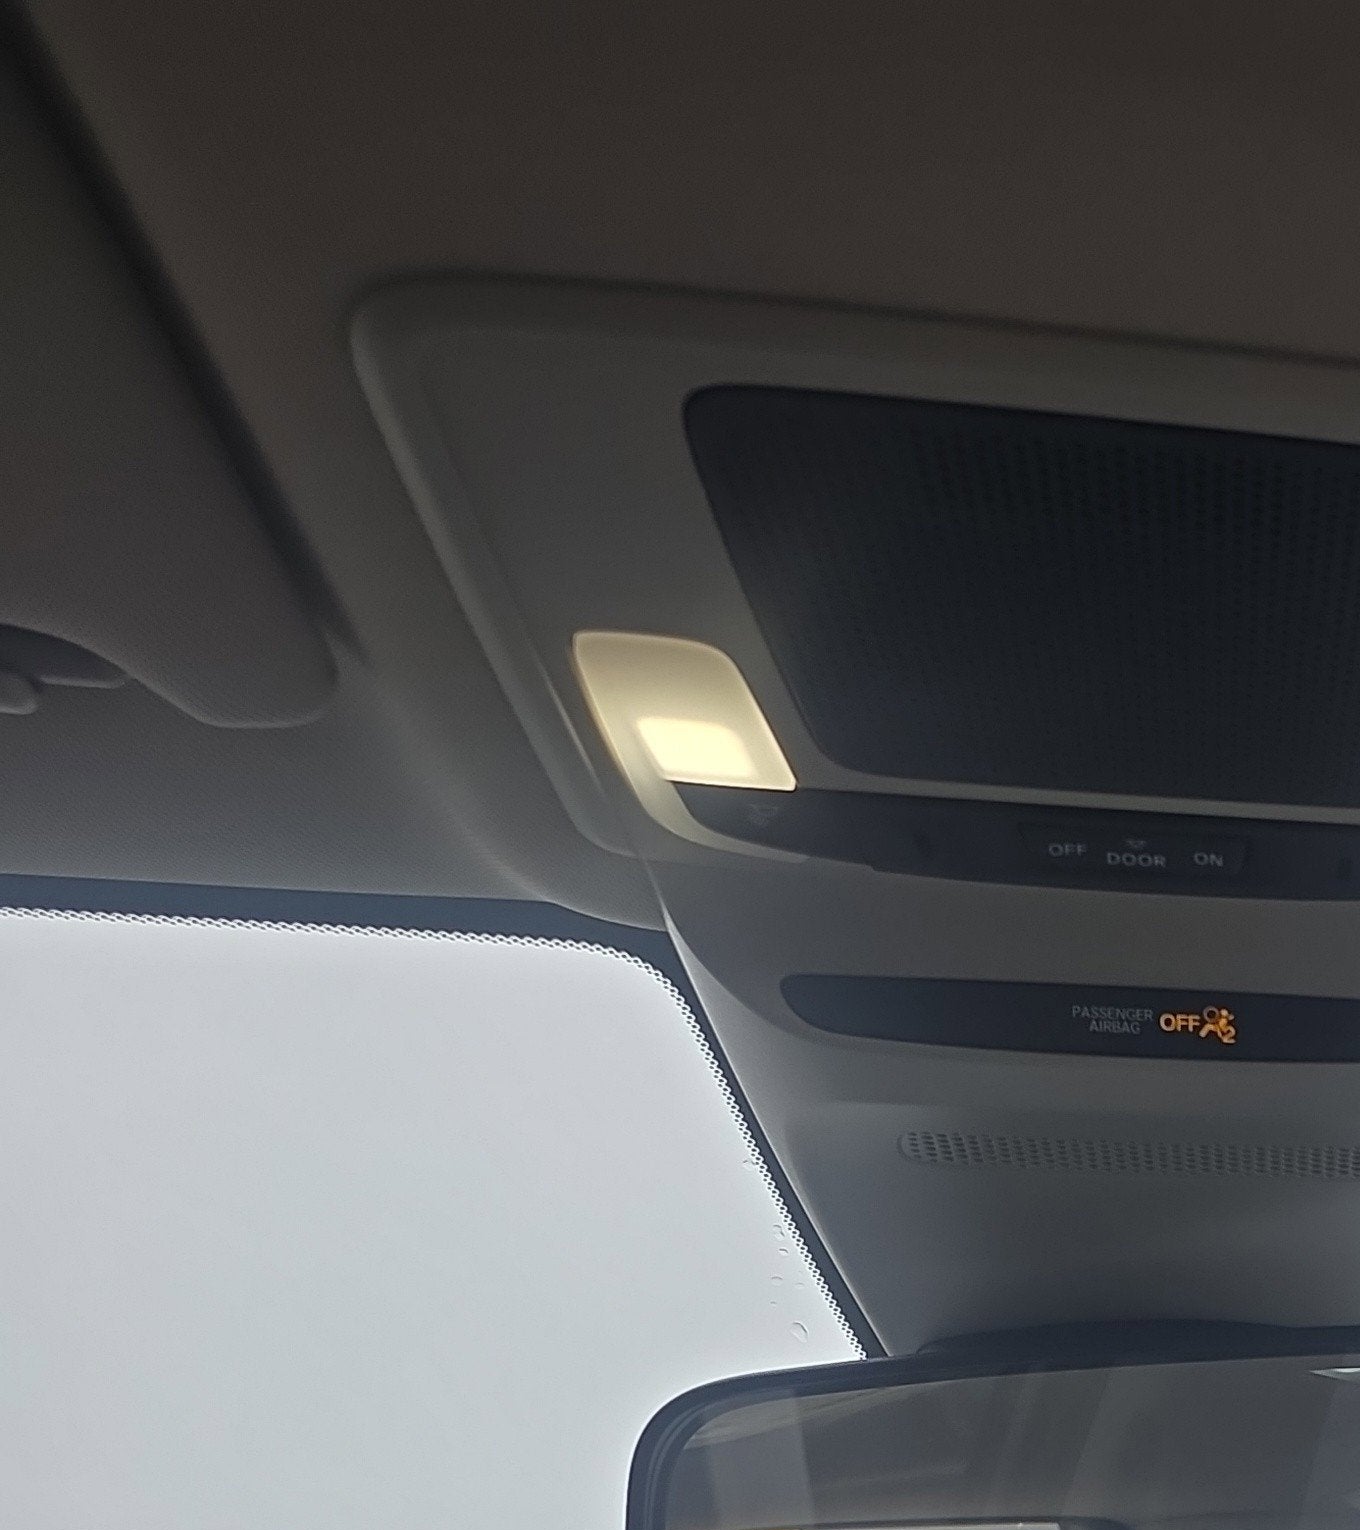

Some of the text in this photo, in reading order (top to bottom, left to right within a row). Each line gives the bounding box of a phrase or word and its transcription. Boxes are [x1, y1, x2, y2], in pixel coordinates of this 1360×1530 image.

[1049, 843, 1086, 857] OFF
[1107, 852, 1167, 867] DOOR
[1194, 852, 1223, 867] ON
[1071, 1004, 1154, 1022] PASSENGER
[1089, 1020, 1141, 1035] AIRBAG
[1159, 1012, 1200, 1033] OFF
